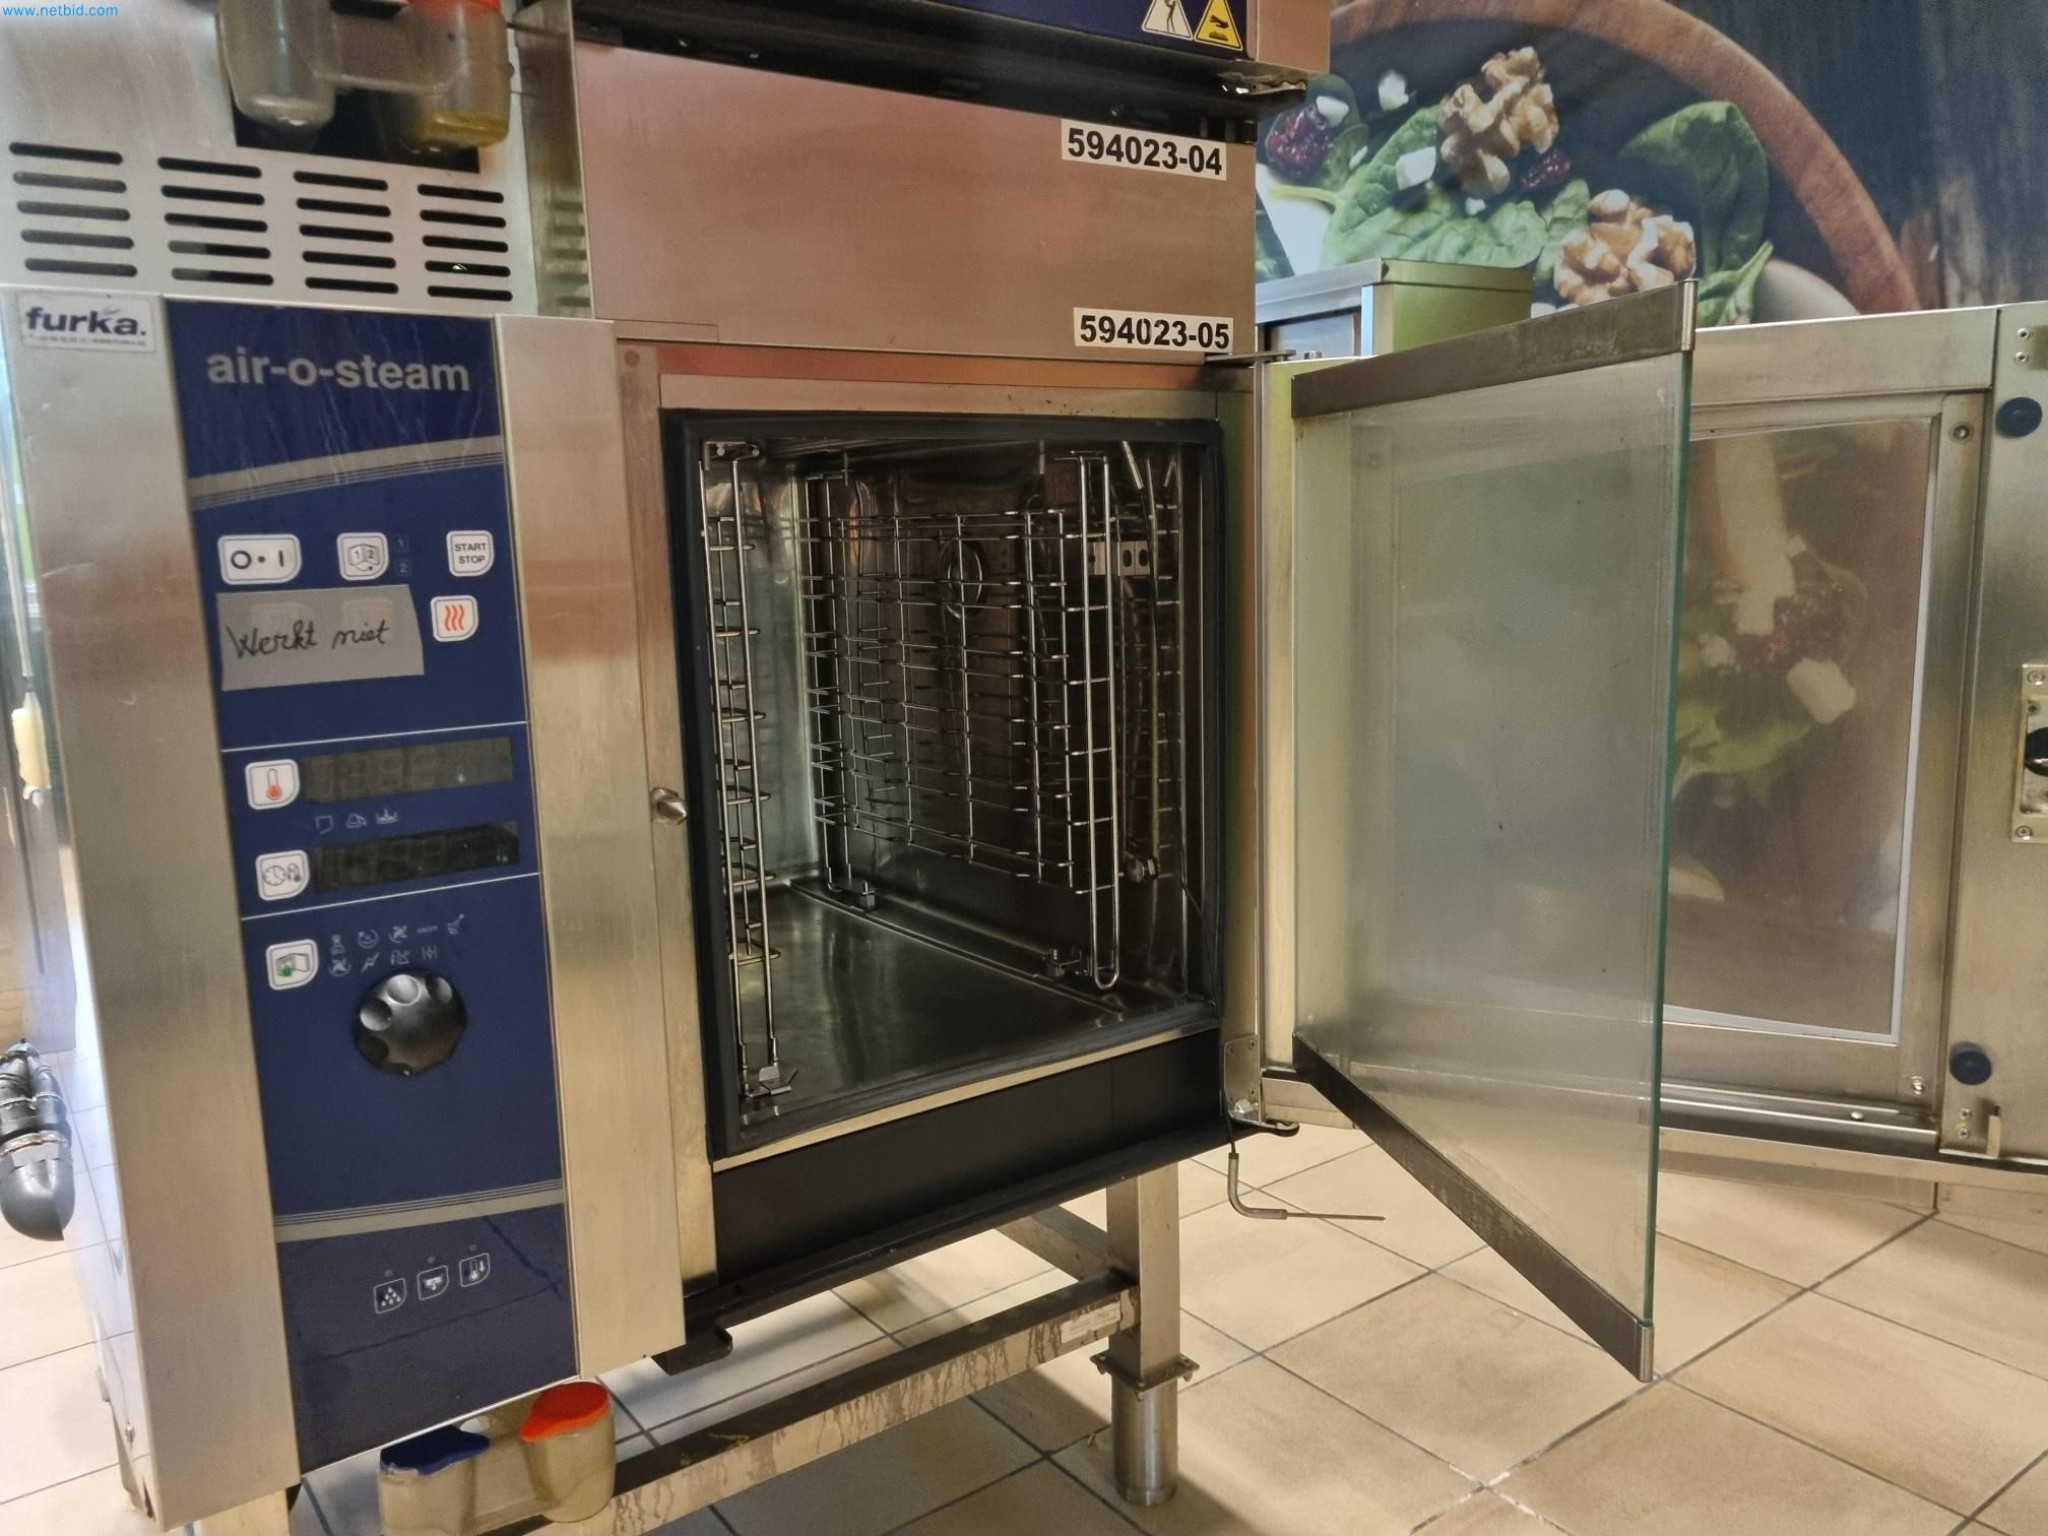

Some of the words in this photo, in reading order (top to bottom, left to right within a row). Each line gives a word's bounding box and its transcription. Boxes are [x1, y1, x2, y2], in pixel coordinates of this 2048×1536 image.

[1067, 127, 1222, 175] 594023-04
[26, 306, 146, 336] furka.
[1080, 314, 1229, 349] 594023-05
[206, 345, 470, 392] air-o-steam
[454, 542, 487, 552] START
[458, 555, 486, 564] STOP
[226, 619, 317, 658] Werkt
